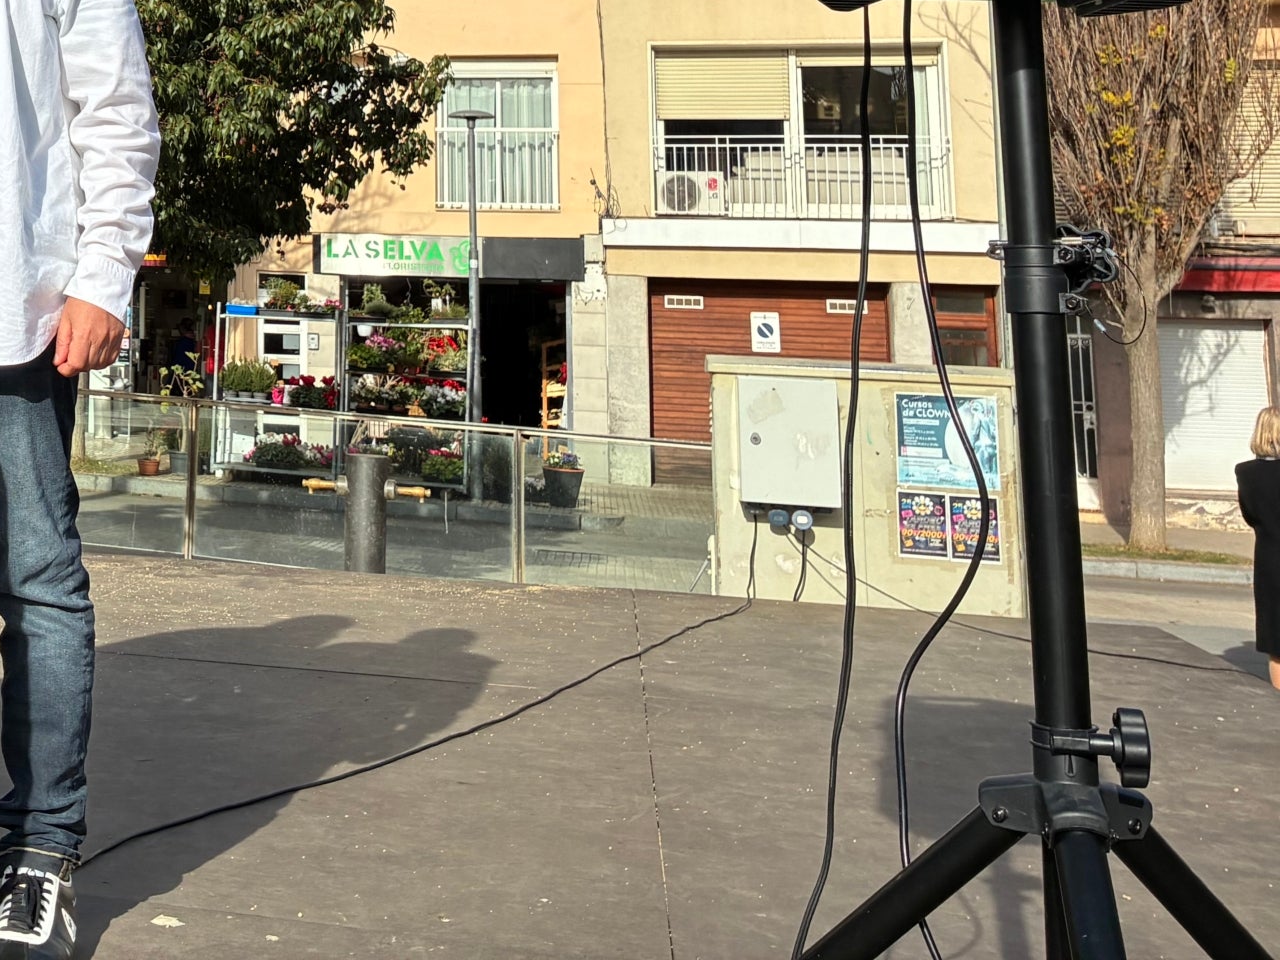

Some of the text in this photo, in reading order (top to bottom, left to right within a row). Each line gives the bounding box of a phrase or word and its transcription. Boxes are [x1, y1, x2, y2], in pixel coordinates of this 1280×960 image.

[326, 238, 444, 261] LA SELVA
[902, 398, 932, 408] Cursos
[903, 409, 914, 417] de
